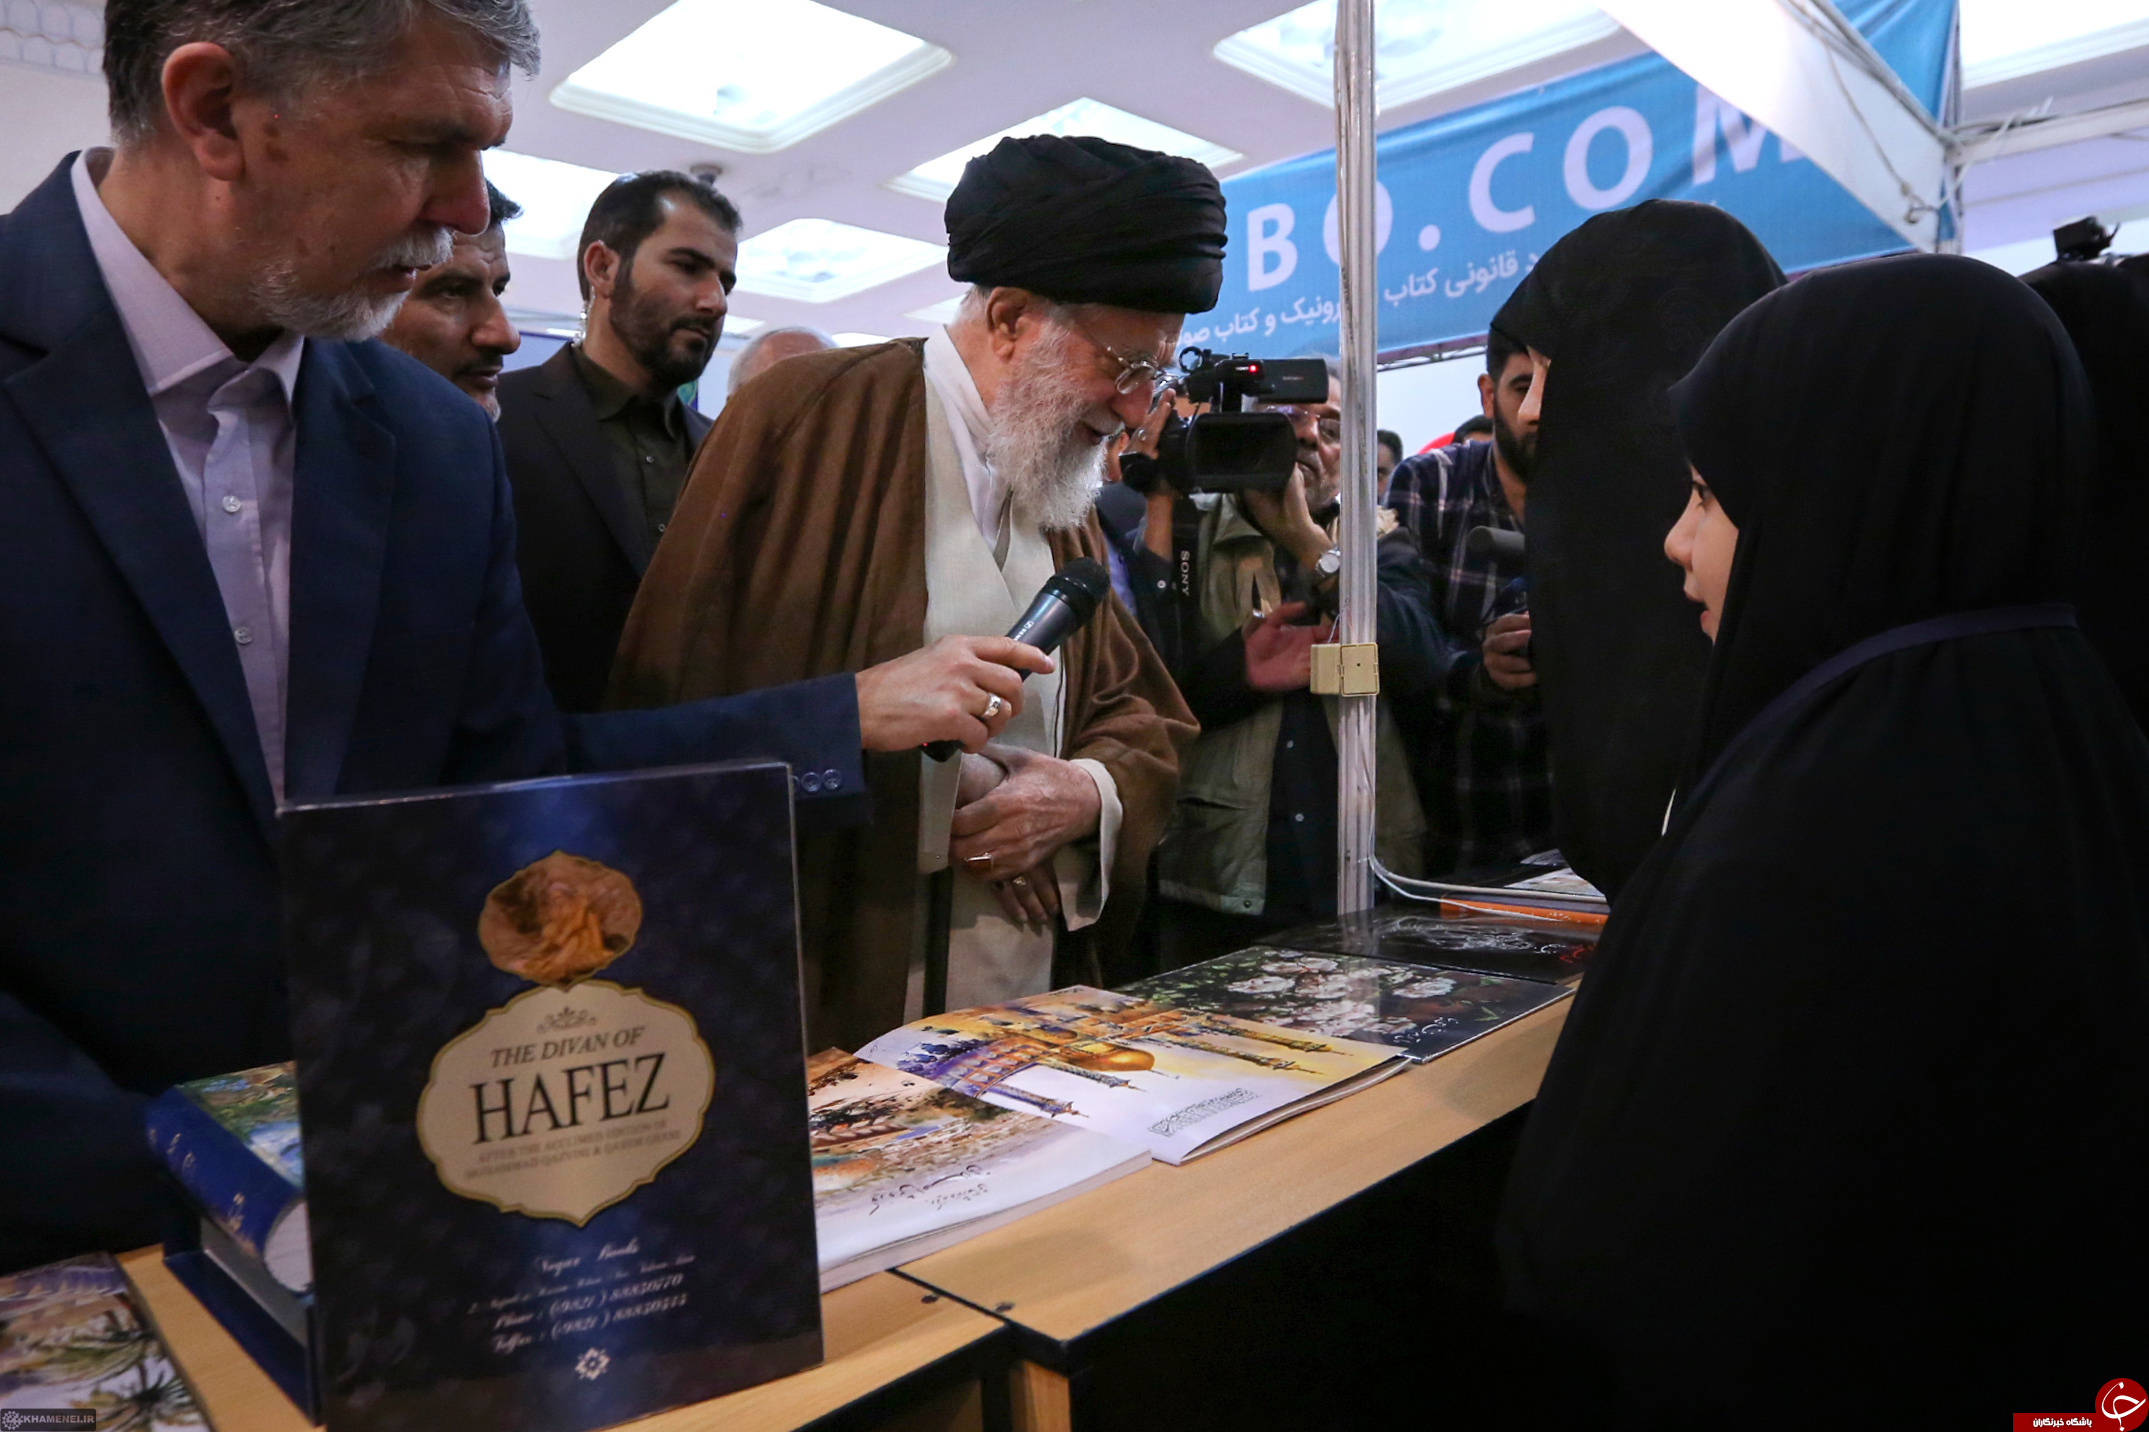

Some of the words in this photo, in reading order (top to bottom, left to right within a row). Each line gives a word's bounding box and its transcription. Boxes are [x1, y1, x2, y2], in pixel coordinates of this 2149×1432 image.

[1384, 267, 1439, 307] کتاب
[1445, 250, 1519, 298] قانونی
[1215, 307, 1261, 342] کتاب
[1265, 312, 1277, 336] و
[1180, 550, 1190, 596] SONY
[491, 1043, 537, 1069] THE
[541, 1033, 609, 1060] DIVAN
[613, 1026, 646, 1047] OF
[469, 1052, 671, 1145] HAFEZ
